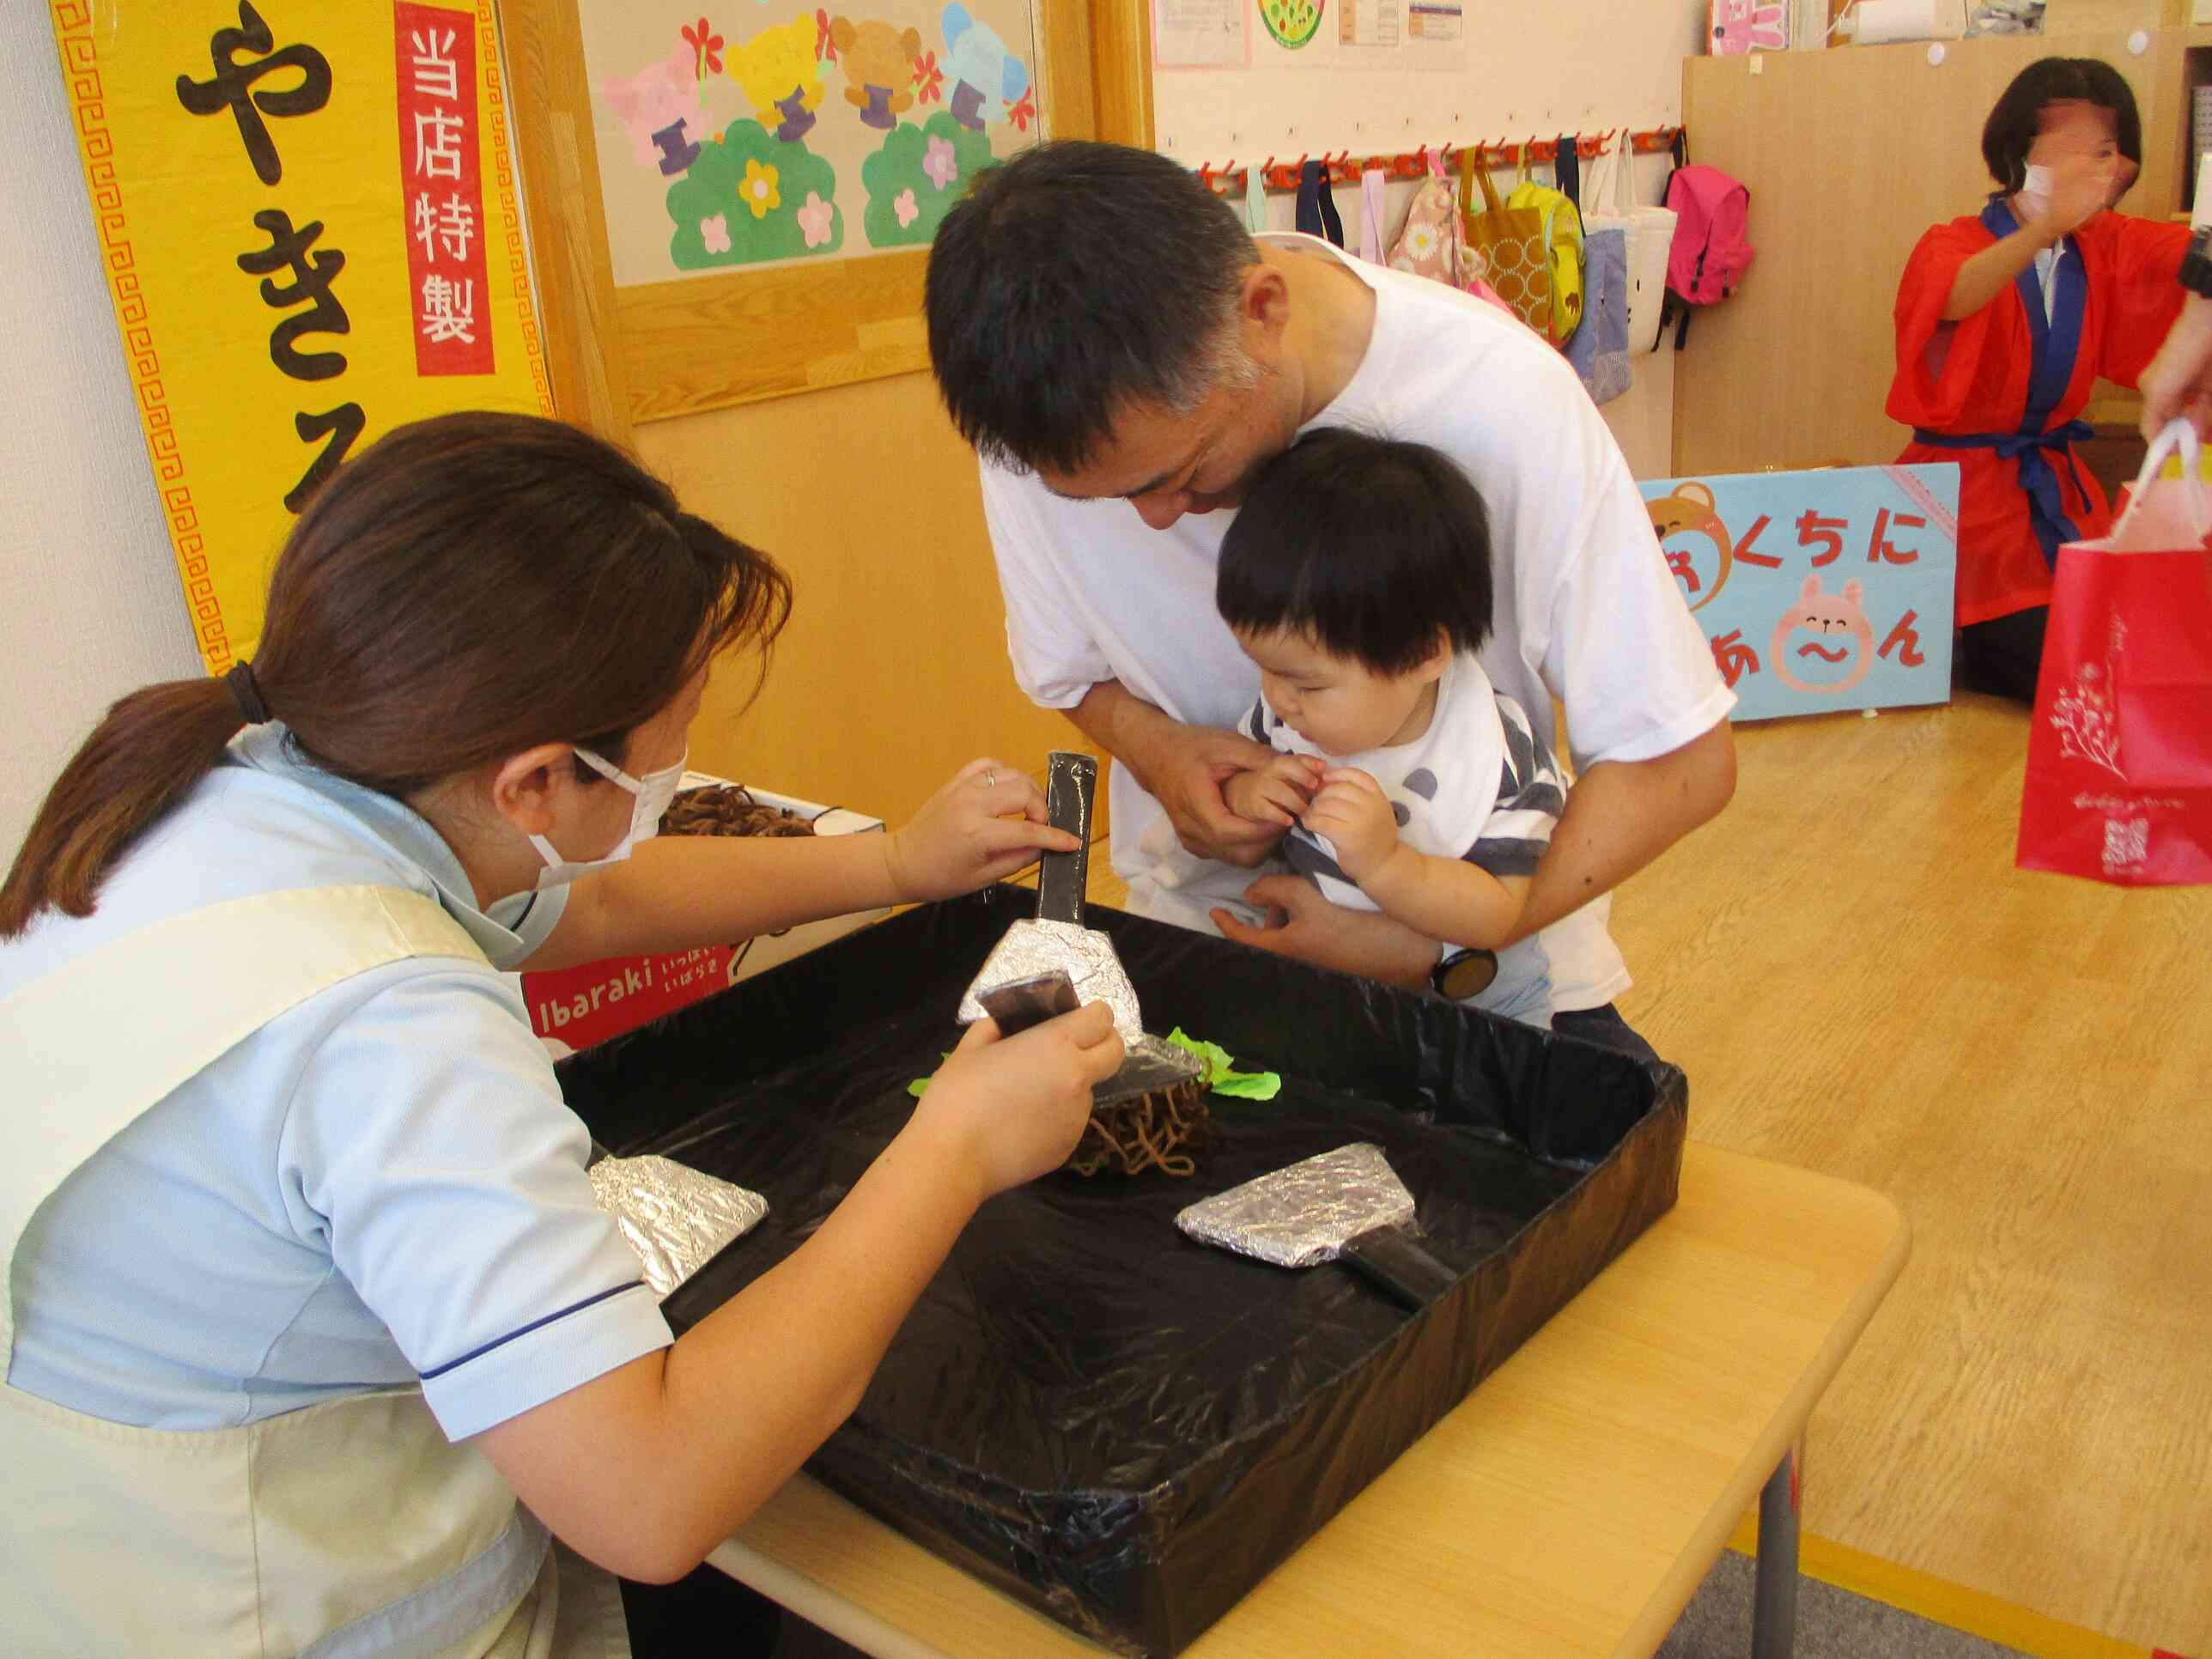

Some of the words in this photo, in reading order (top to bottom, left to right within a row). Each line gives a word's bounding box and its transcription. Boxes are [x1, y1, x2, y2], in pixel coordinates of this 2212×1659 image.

[411, 27, 477, 345] 当店特製
[538, 957, 653, 1034] Ibaraki
